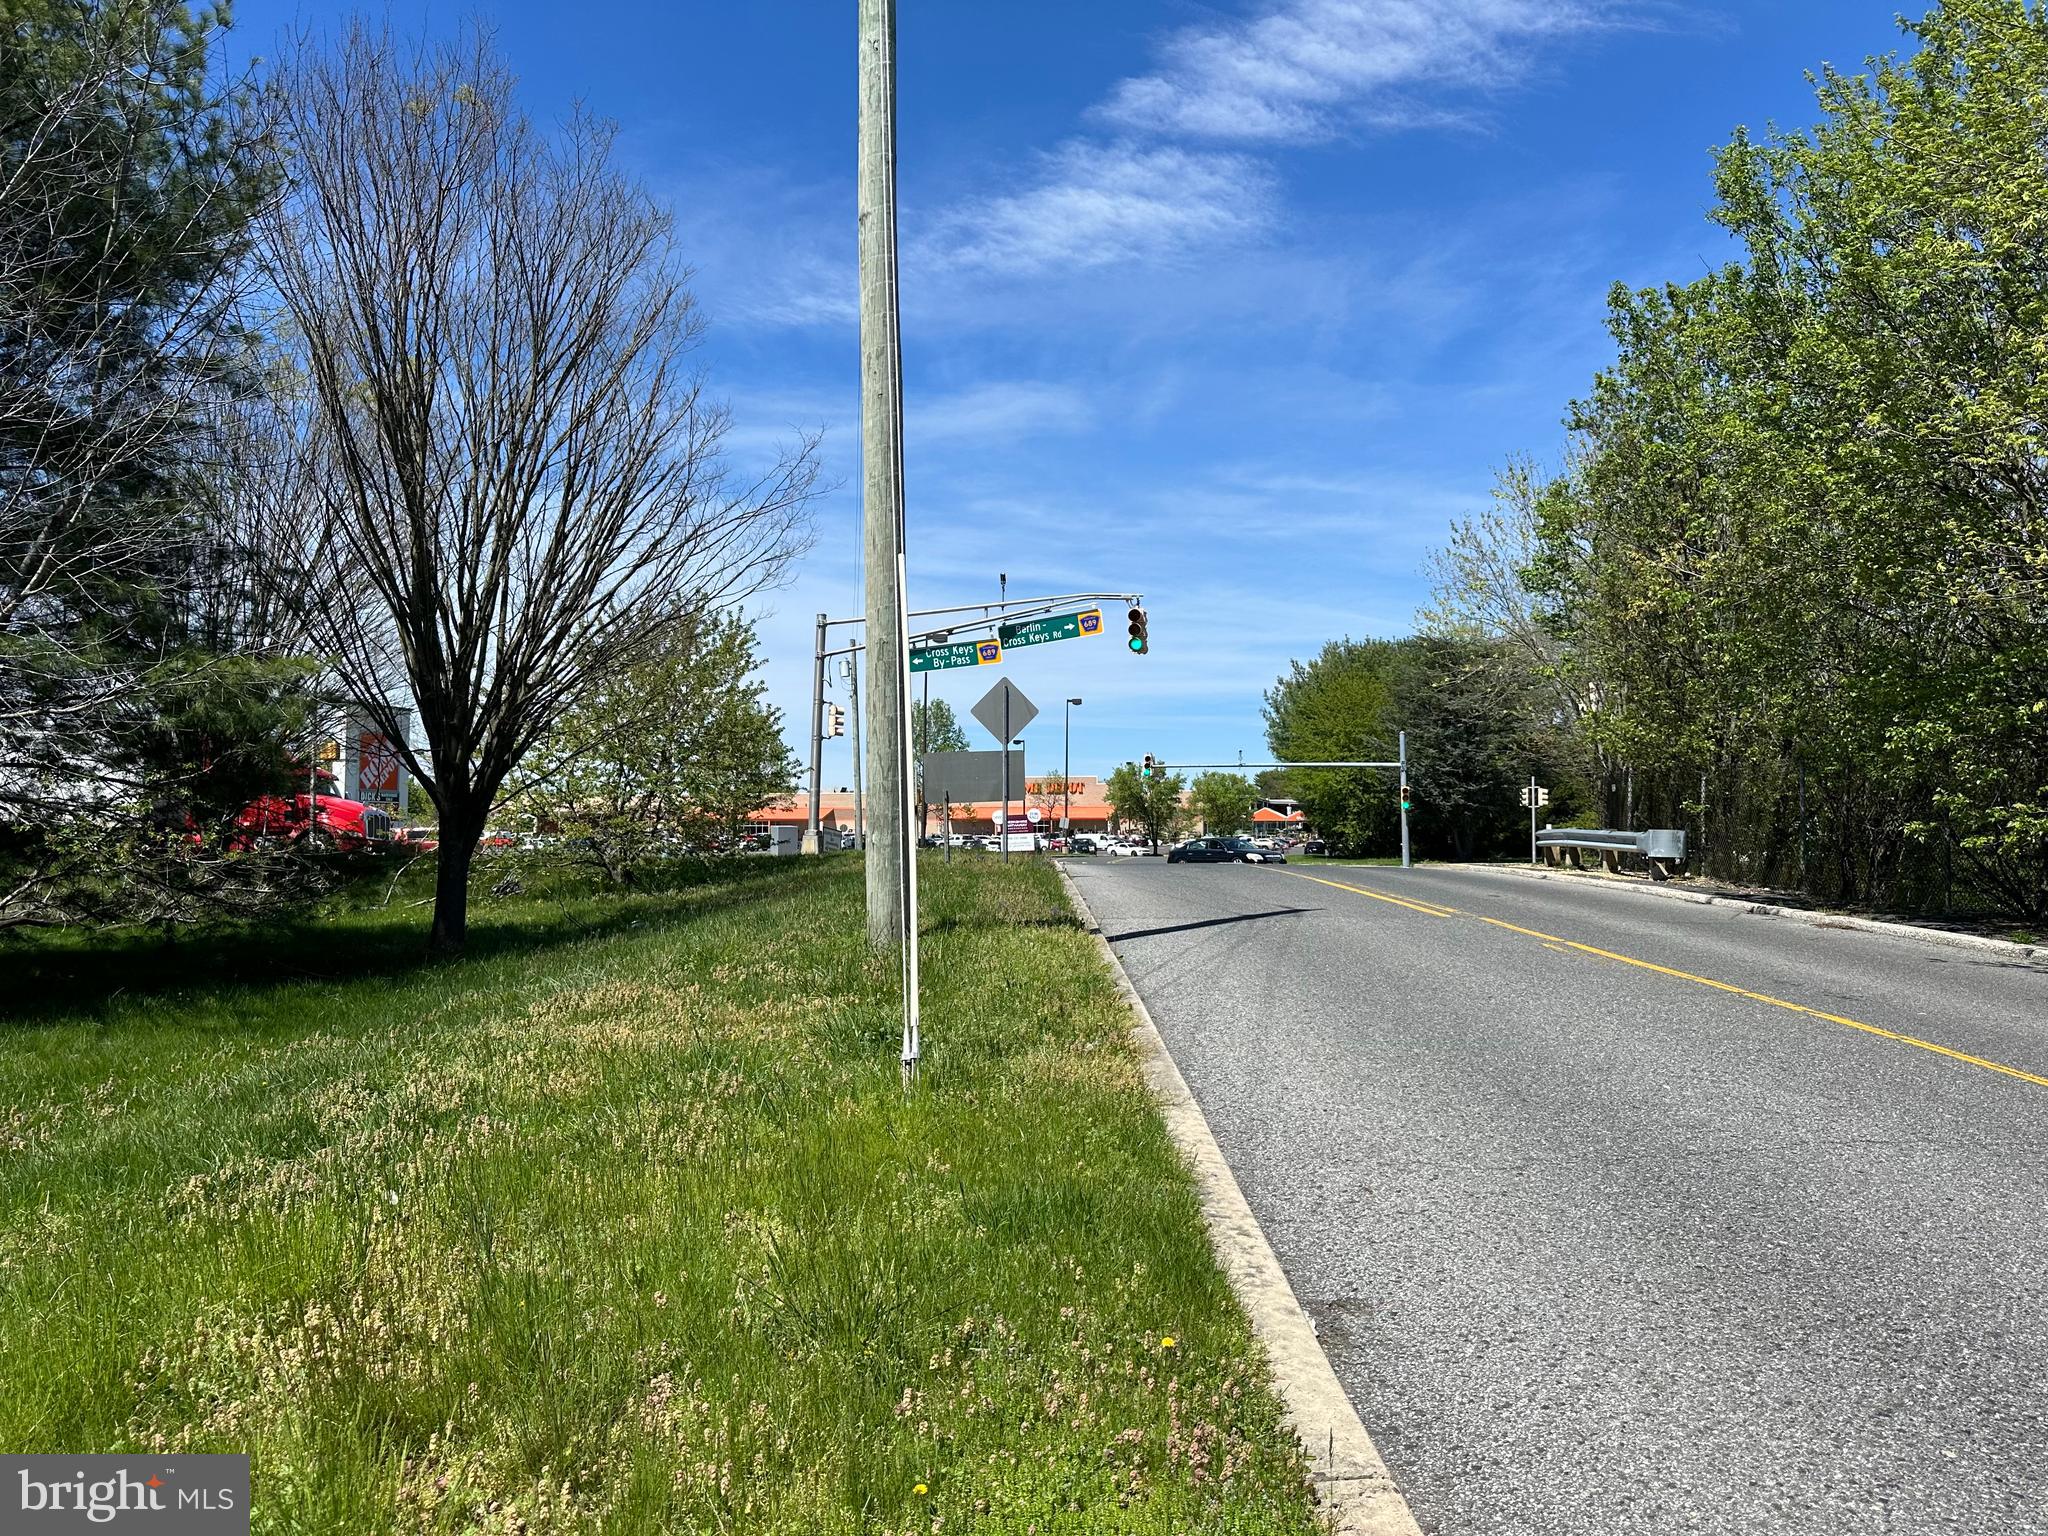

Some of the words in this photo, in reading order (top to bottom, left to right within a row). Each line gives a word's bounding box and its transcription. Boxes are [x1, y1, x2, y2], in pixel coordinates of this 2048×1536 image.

[1083, 619, 1096, 627] 689
[1003, 637, 1026, 647] Cross
[1029, 631, 1050, 643] Keys
[1053, 630, 1062, 639] Rd
[926, 648, 949, 658] Cross
[952, 645, 974, 655] Keys
[982, 649, 996, 657] 689
[933, 656, 971, 668] By-Pass
[360, 791, 381, 801] DICKS
